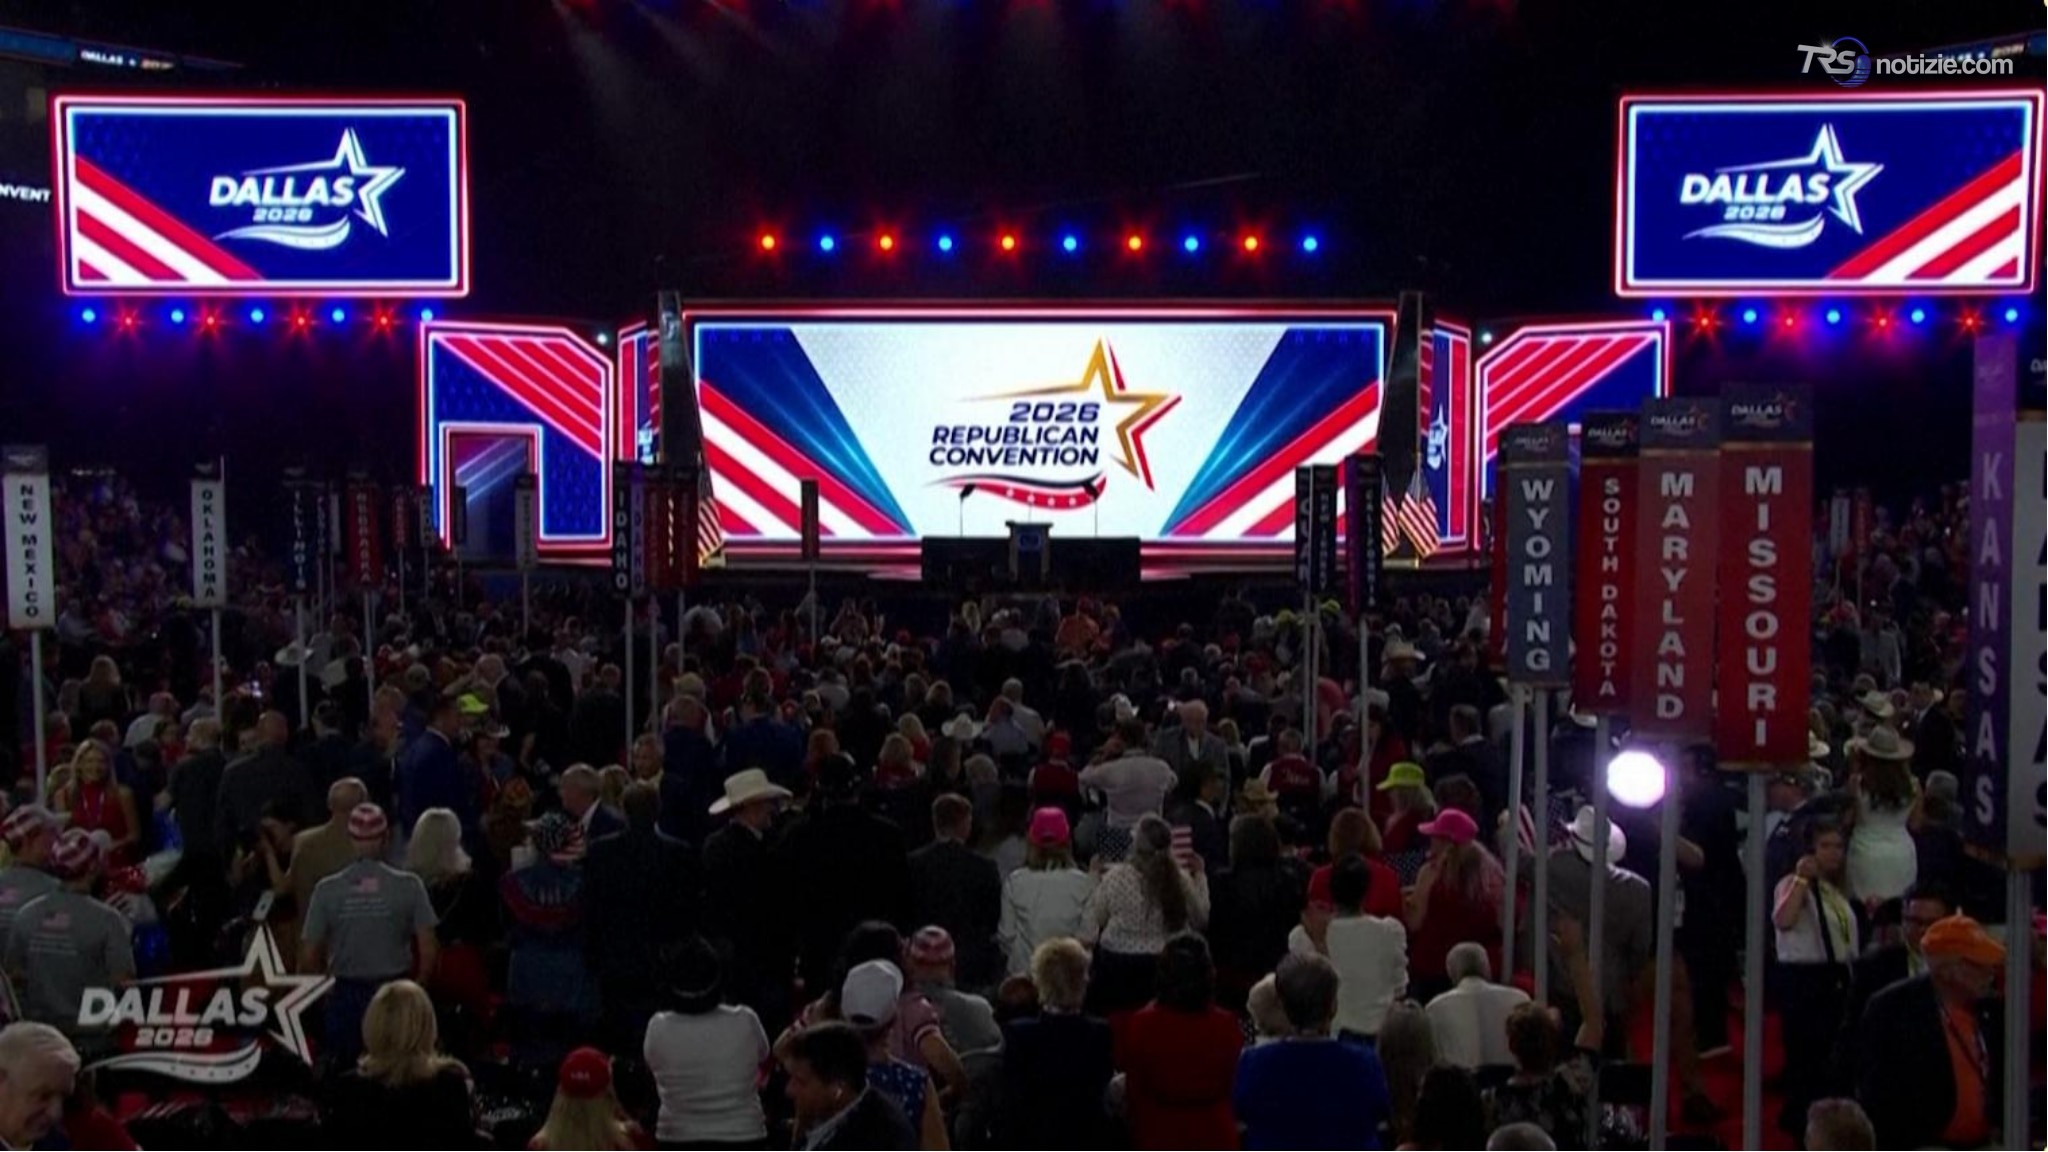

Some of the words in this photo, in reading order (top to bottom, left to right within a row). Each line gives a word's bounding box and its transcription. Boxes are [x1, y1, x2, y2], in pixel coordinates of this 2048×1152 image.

[209, 176, 355, 206] DALLAS
[252, 208, 313, 221] 2026
[1679, 173, 1830, 203] DALLAS
[1723, 205, 1786, 219] 2026
[931, 426, 1100, 445] REPUBLICAN
[1008, 402, 1100, 423] 2026
[929, 447, 1100, 466] CONVENTION
[19, 485, 37, 525] NEW
[202, 490, 216, 598] OKLAHOMA
[615, 490, 629, 589] IDAHO
[1601, 478, 1622, 572] SOUTH
[22, 534, 39, 617] MEXICO
[1521, 479, 1555, 672] WYOMING
[1656, 472, 1694, 719] MARYLAND
[1744, 466, 1783, 747] MISSOURI
[1599, 582, 1620, 697] DAKOTA
[1975, 452, 2003, 826] KANSAS
